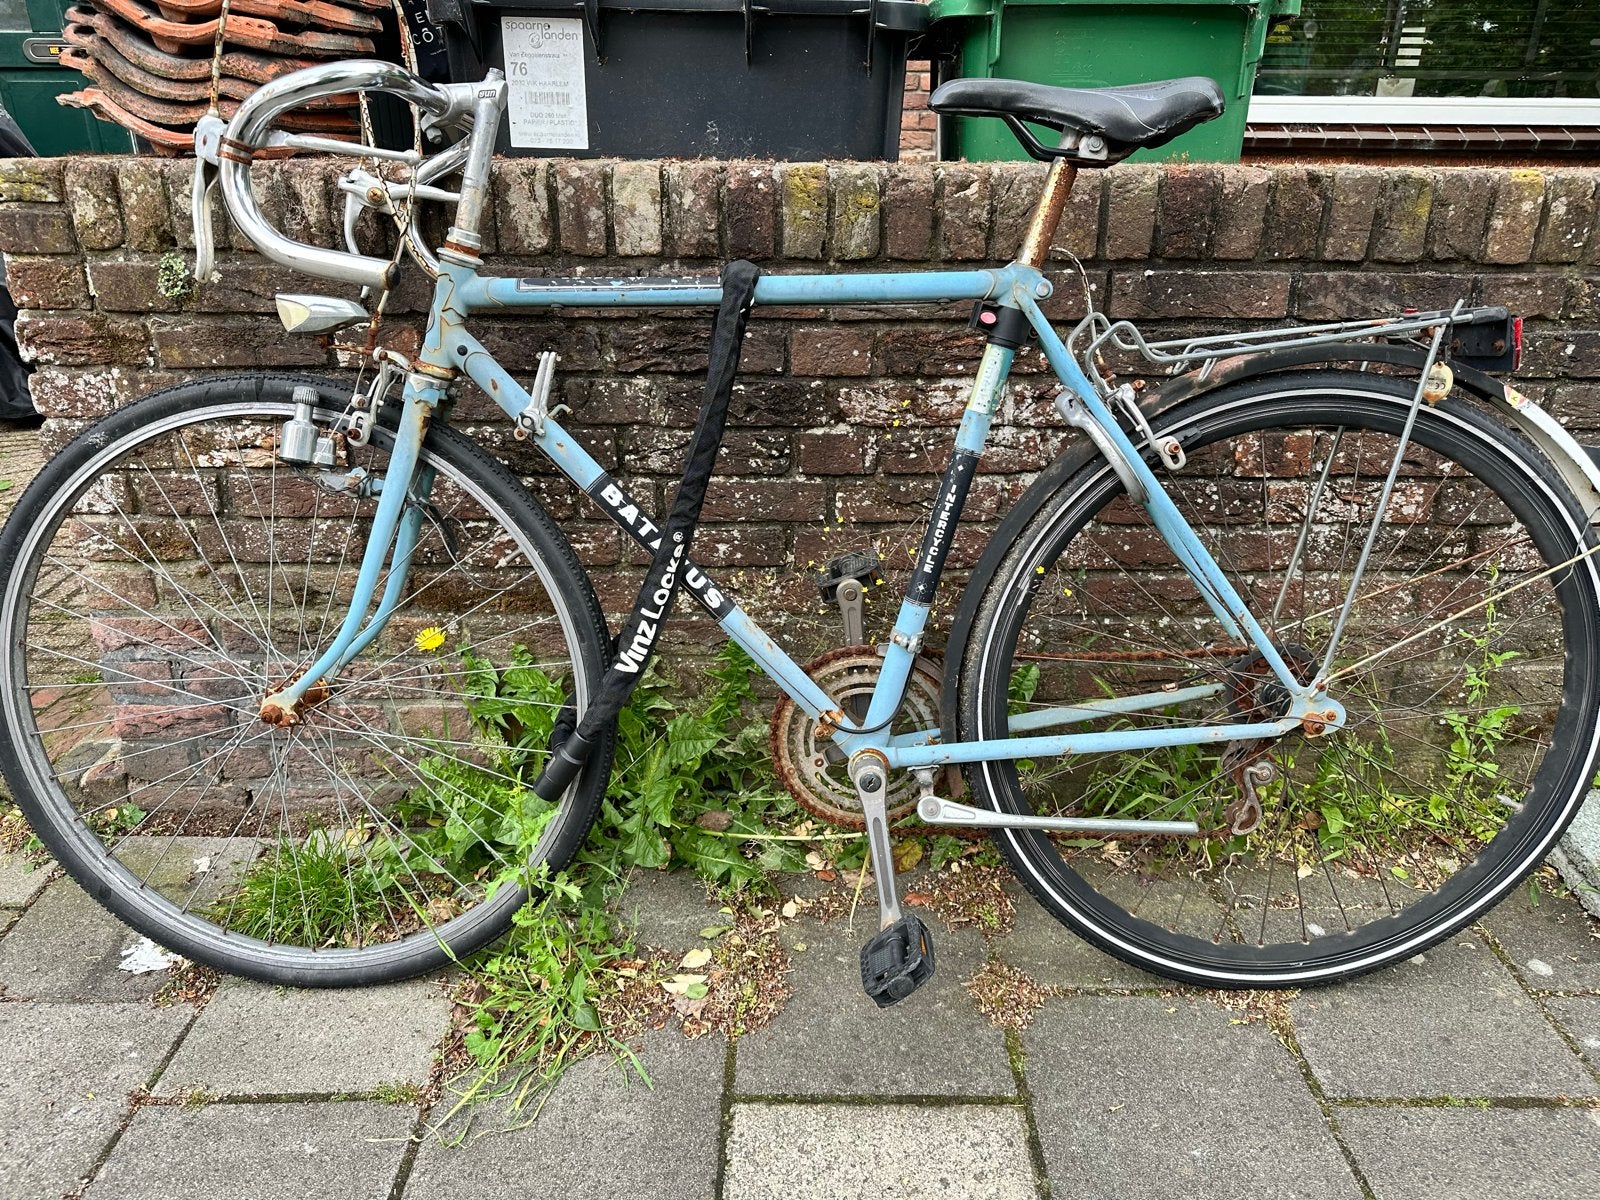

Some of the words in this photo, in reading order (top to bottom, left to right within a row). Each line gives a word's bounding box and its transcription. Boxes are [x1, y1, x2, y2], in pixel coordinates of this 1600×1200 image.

[505, 20, 549, 32] spaarne
[541, 28, 578, 41] landen
[510, 61, 528, 77] 76
[923, 485, 957, 573] INTERCYCLE
[600, 483, 725, 609] BATUS
